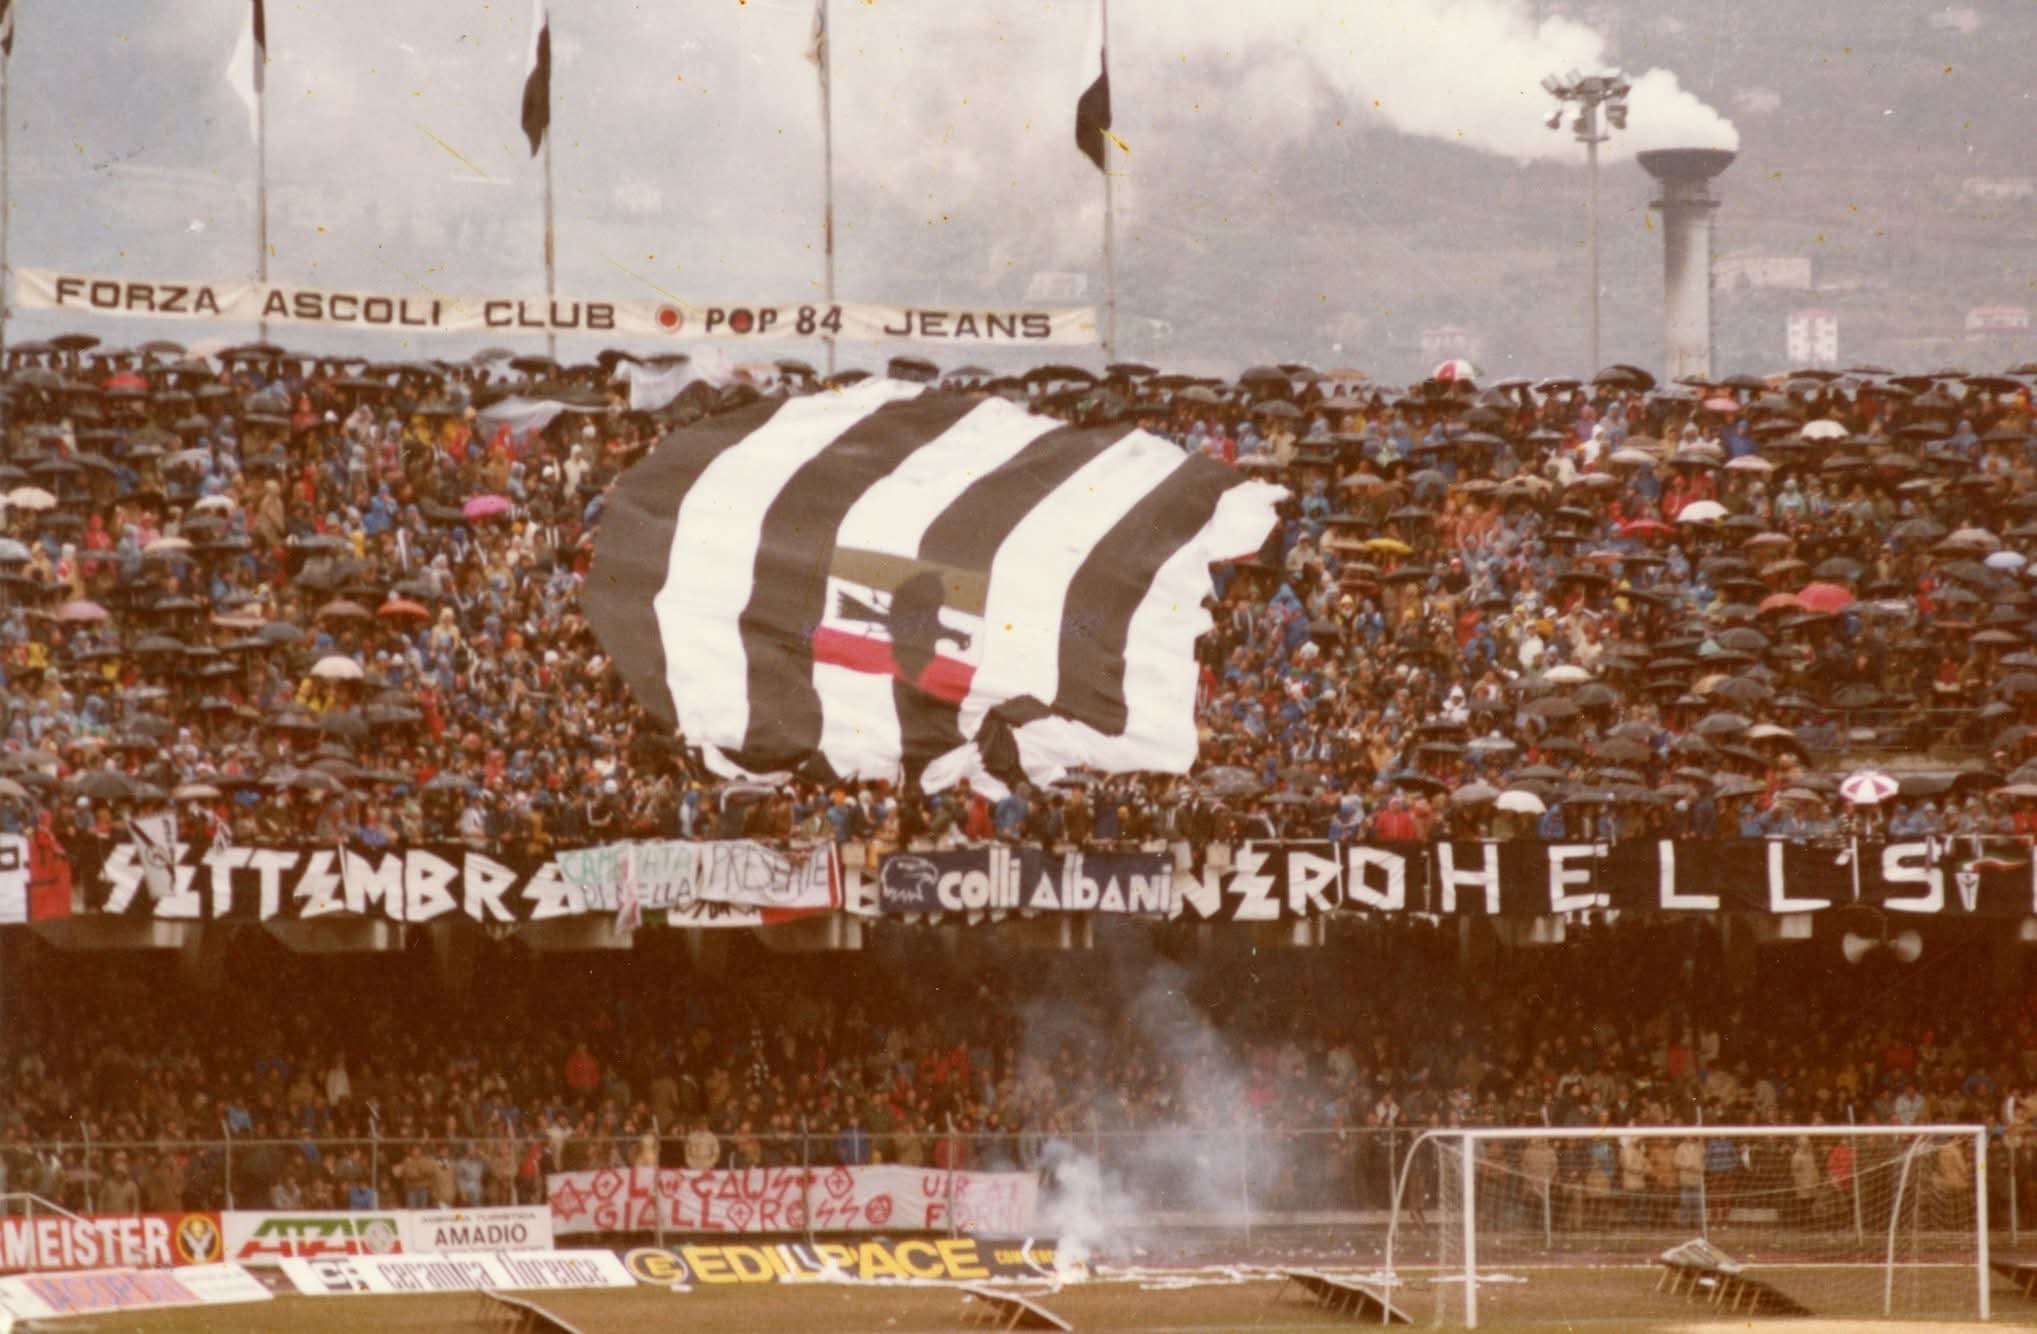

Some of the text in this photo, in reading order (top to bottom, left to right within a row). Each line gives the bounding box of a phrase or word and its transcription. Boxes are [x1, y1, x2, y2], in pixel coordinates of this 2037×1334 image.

[56, 278, 1052, 338] FORZA ASCOLI CLUB POP 84 JEANS
[937, 846, 1020, 912] colli
[1438, 839, 1945, 914] HELLS
[0, 1217, 172, 1268] MEISTER
[433, 1223, 528, 1248] AMADIO
